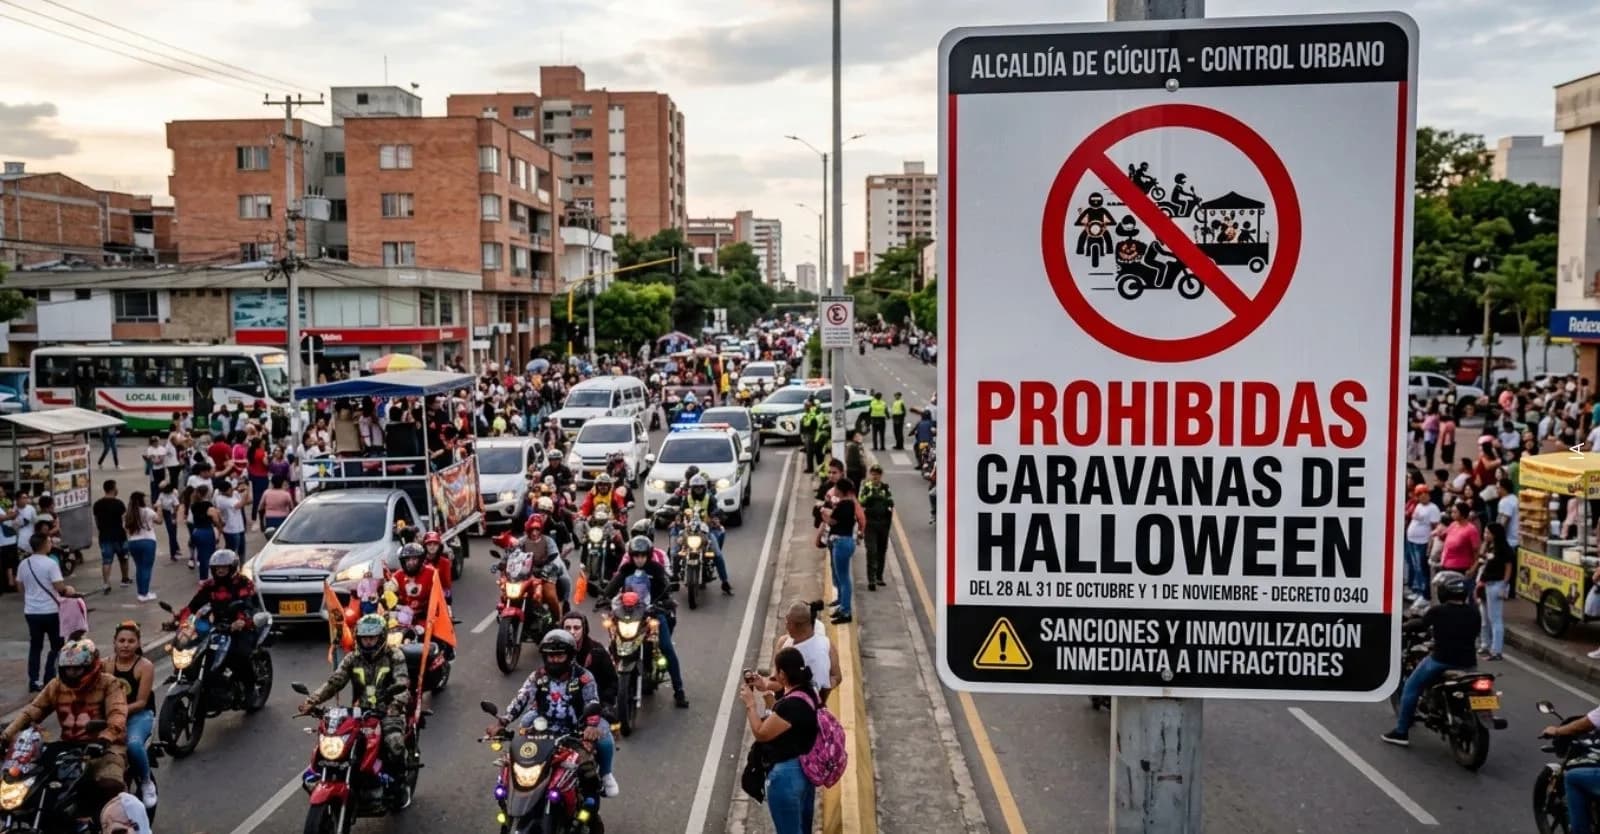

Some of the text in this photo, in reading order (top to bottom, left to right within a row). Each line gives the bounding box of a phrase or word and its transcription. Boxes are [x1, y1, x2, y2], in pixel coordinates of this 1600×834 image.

[970, 46, 1067, 79] ALCALDÍA
[1072, 51, 1098, 76] DE
[1103, 44, 1181, 75] CÚCUTA
[1201, 44, 1294, 72] CONTROL
[1300, 41, 1385, 69] URBANO
[126, 393, 158, 401] LOCAL
[977, 380, 1367, 449] PROHIBIDAS
[976, 453, 1366, 509] CARAVANAS DE
[977, 511, 1363, 579] HALLOWEEN
[969, 579, 994, 596] DEL
[996, 580, 1014, 597] 28
[1015, 580, 1033, 597] AL
[1036, 580, 1052, 597] 31
[1056, 581, 1073, 598] DE
[1076, 581, 1135, 599] OCTUBRE
[1138, 583, 1147, 599] Y
[1151, 583, 1158, 600] 1
[1162, 583, 1180, 600] DE
[1182, 584, 1259, 602] NOVIEMBRE
[1271, 585, 1331, 603] DECRETO
[1333, 586, 1369, 604] 0340
[1039, 617, 1361, 649] SANCIONES Y INMOVILIZACIÓN
[1056, 646, 1344, 677] INMEDIATA A INFRACTORES
